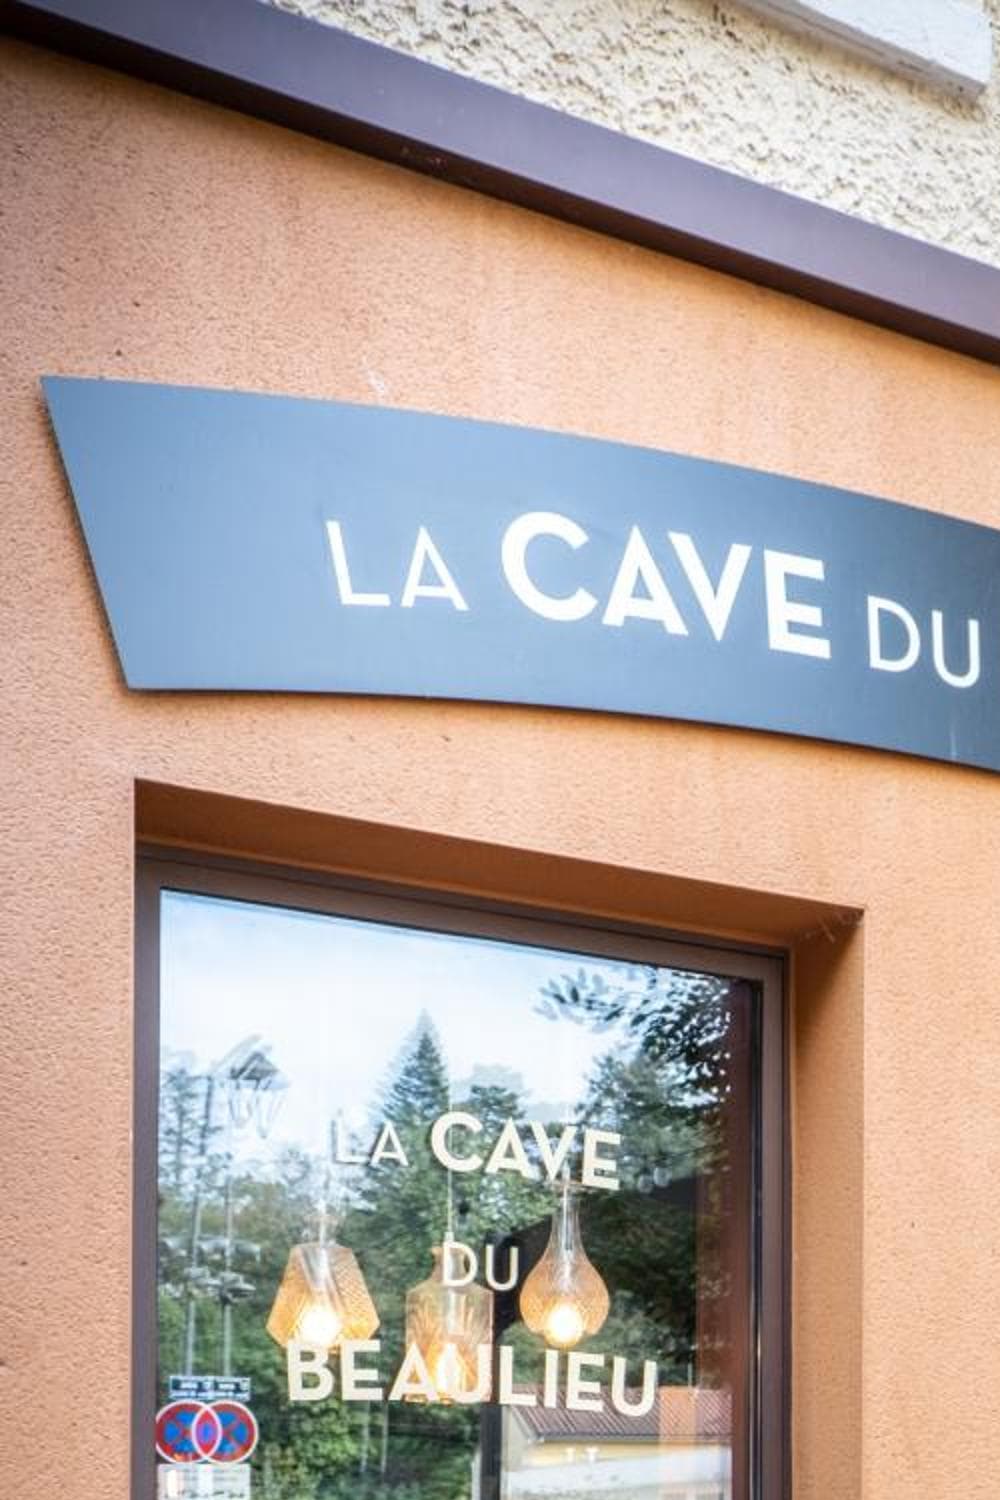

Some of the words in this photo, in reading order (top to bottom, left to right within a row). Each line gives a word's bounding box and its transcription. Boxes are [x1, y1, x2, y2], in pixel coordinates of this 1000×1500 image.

[326, 520, 469, 610] LA
[501, 511, 831, 659] CAVE
[867, 595, 980, 689] DU
[333, 1108, 409, 1167] LA
[431, 1111, 621, 1190] CAVE
[442, 1240, 519, 1291] DU
[286, 1338, 658, 1417] BEAULIEU
